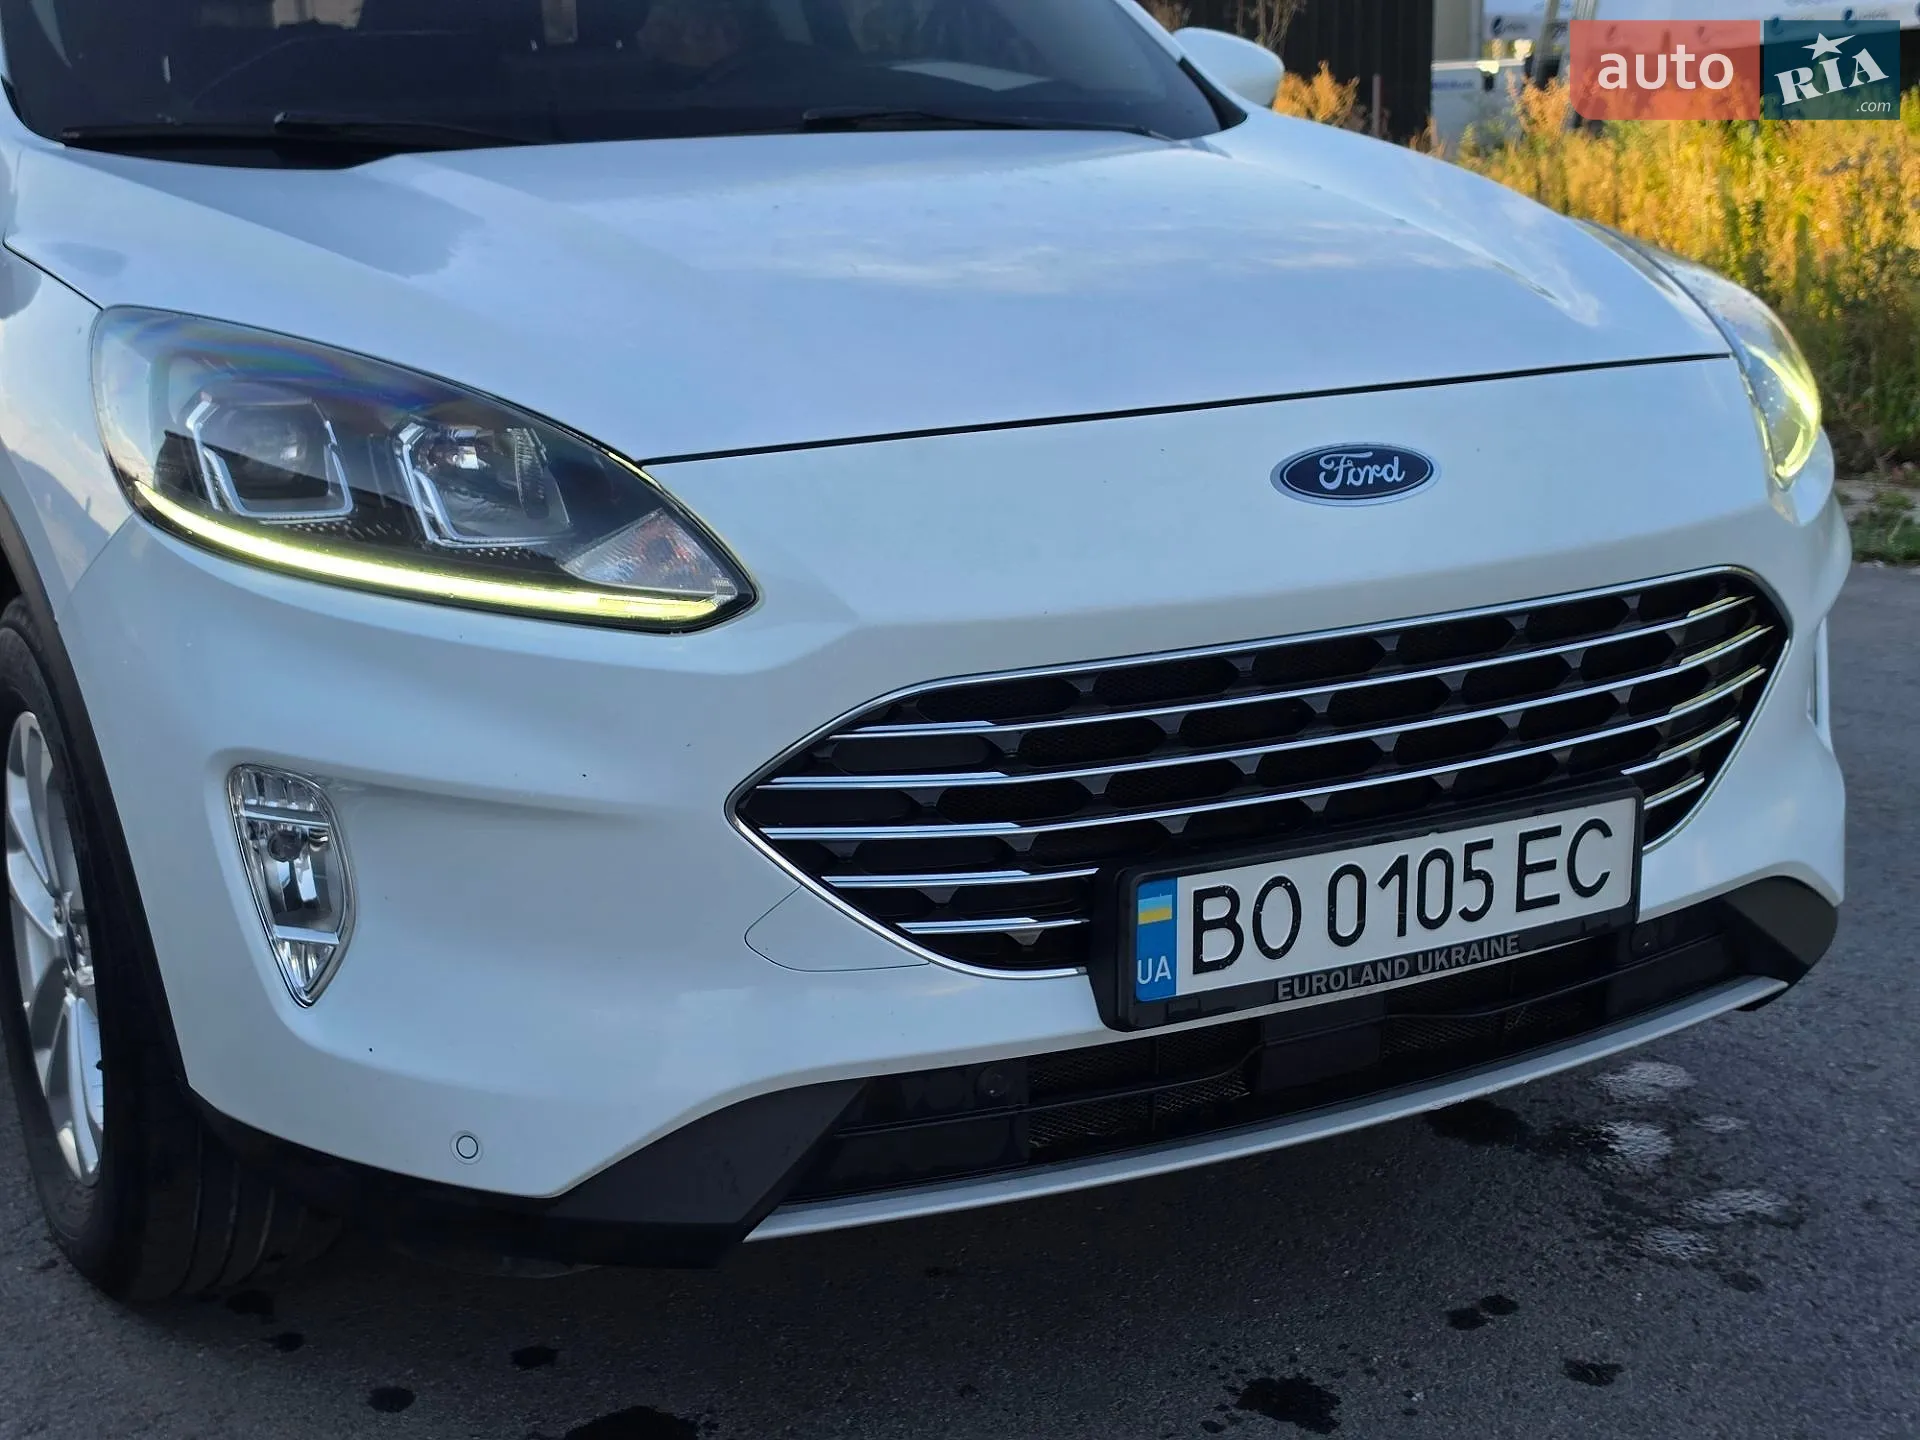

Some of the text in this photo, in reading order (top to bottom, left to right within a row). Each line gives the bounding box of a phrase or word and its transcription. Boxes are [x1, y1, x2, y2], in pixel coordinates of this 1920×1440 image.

[1318, 452, 1405, 491] Ford
[1192, 818, 1613, 976] BO 0105 EC
[1136, 958, 1172, 986] UA
[1277, 933, 1520, 1002] EUROLAND UKRAINE
